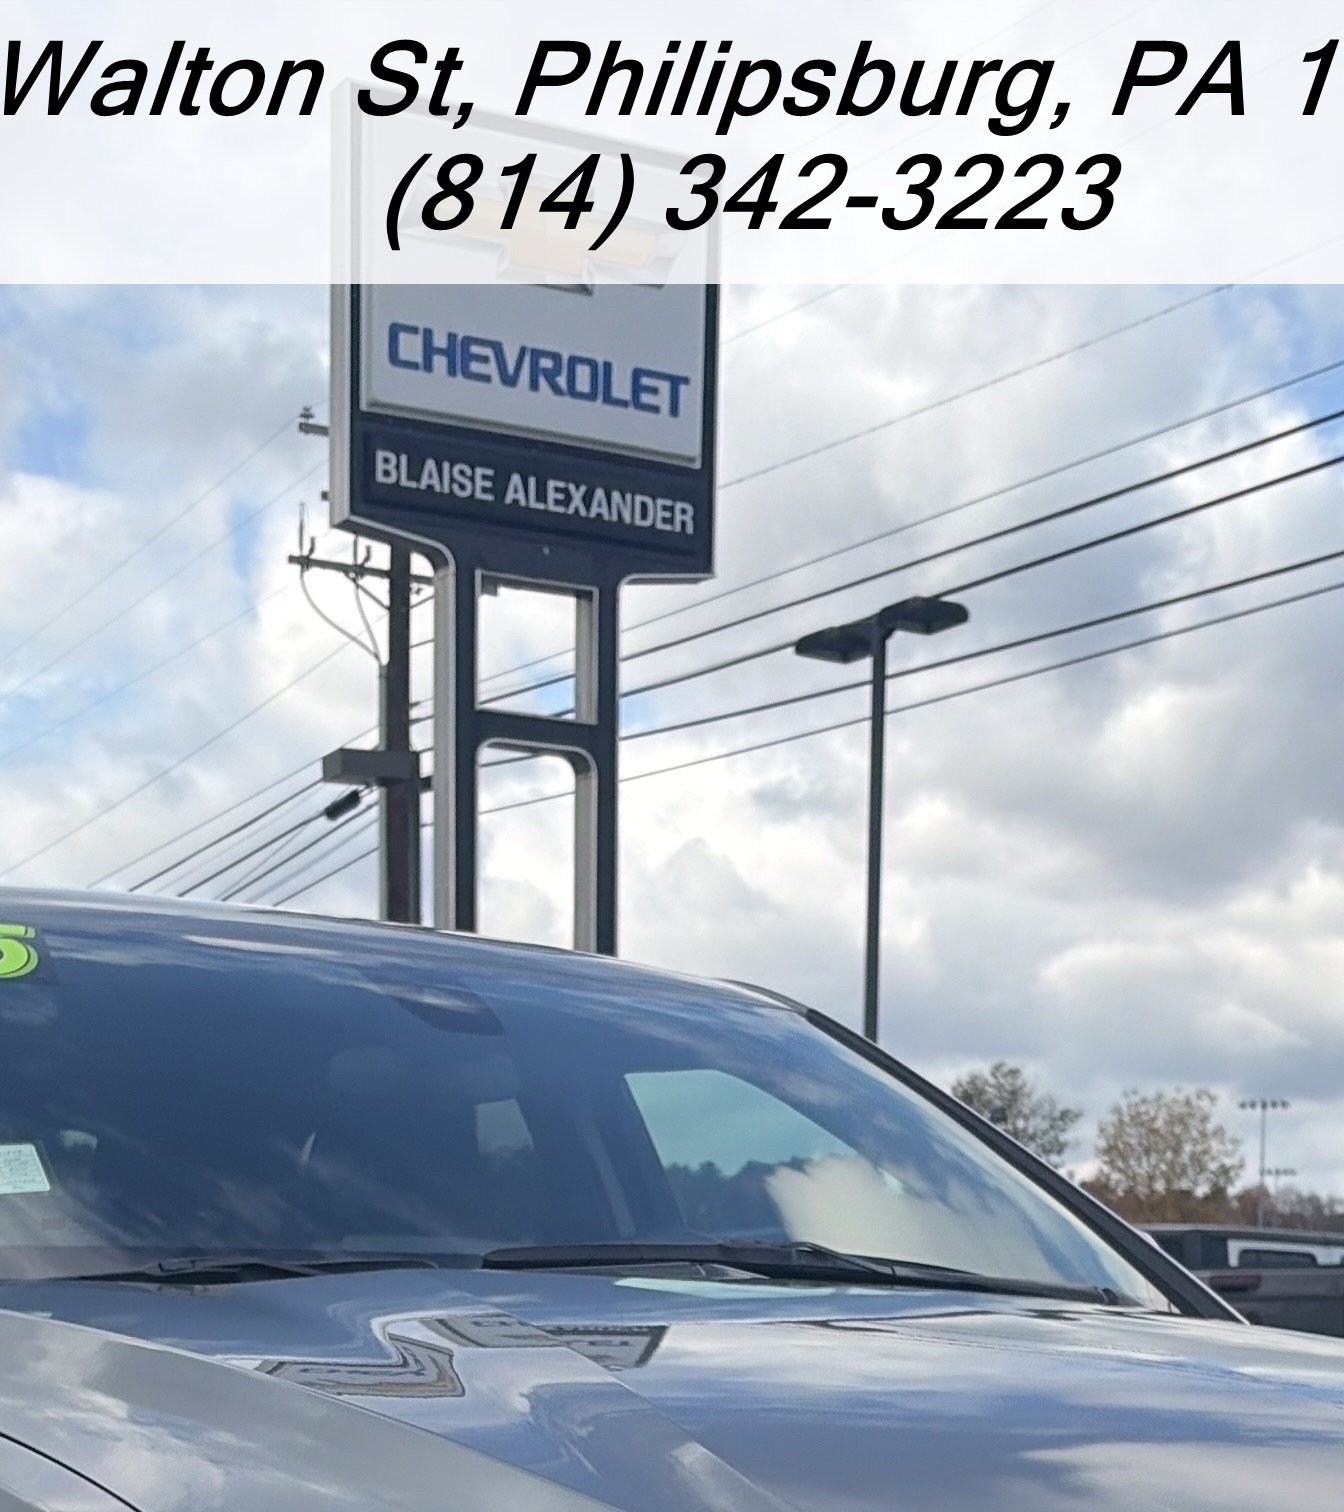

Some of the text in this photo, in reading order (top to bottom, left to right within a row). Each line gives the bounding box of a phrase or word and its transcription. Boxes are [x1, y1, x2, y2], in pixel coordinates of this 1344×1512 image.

[387, 321, 691, 418] CHEVROLET
[374, 448, 696, 535] BLAISE ALEXANDER
